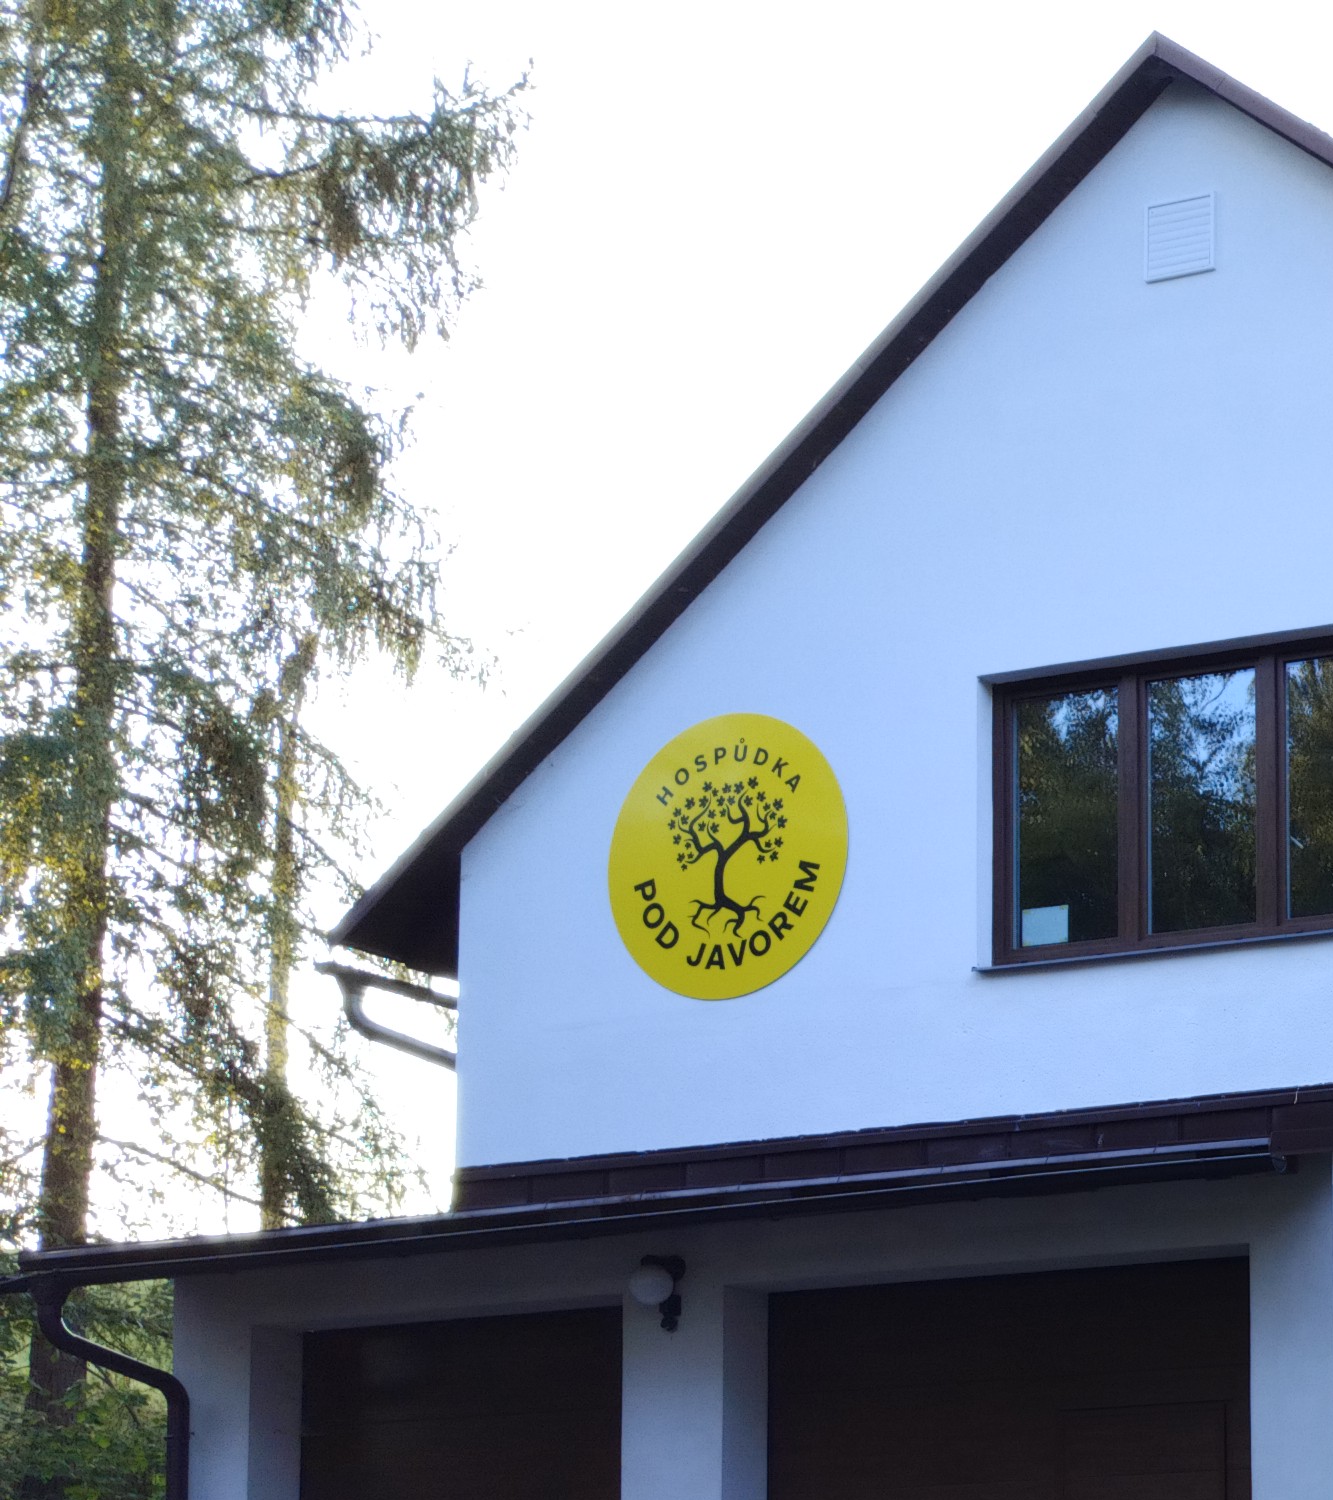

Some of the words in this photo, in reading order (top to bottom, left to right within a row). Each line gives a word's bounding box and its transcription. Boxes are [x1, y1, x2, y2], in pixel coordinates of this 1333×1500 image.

[656, 737, 801, 807] HOSPŮDKA
[634, 878, 679, 949] POD
[687, 860, 820, 970] JAVOREM
